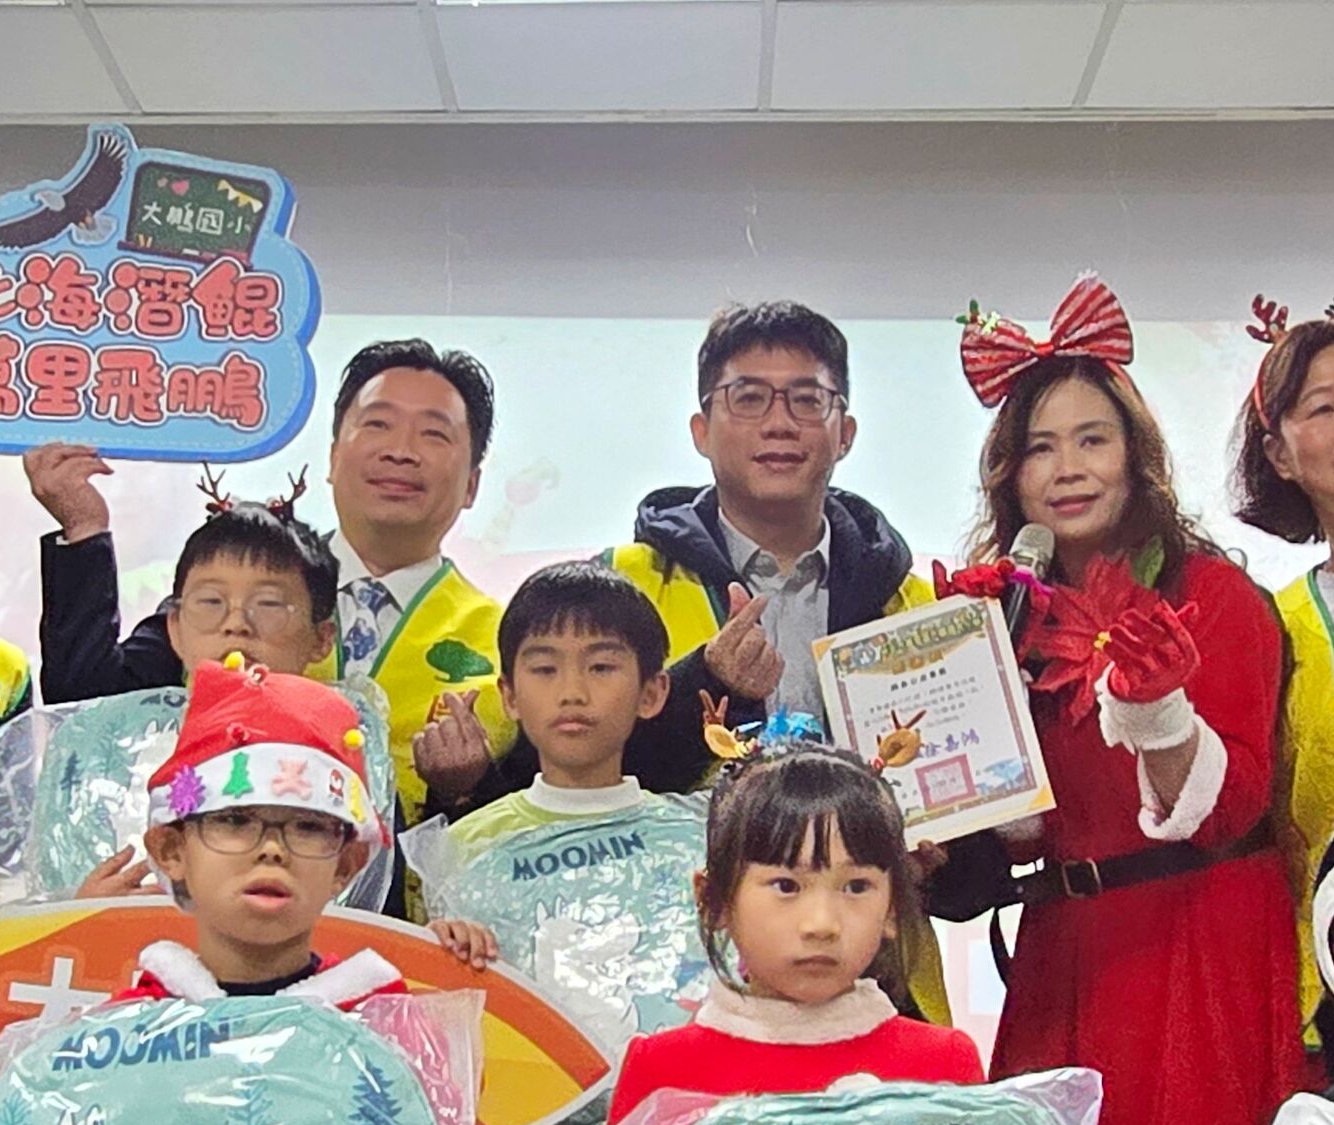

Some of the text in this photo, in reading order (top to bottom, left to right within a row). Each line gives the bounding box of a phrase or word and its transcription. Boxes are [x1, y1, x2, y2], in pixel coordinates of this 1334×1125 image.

[142, 201, 251, 235] 大鵬國小
[512, 832, 646, 882] MOOMIN
[52, 1016, 231, 1072] MOOMIN
